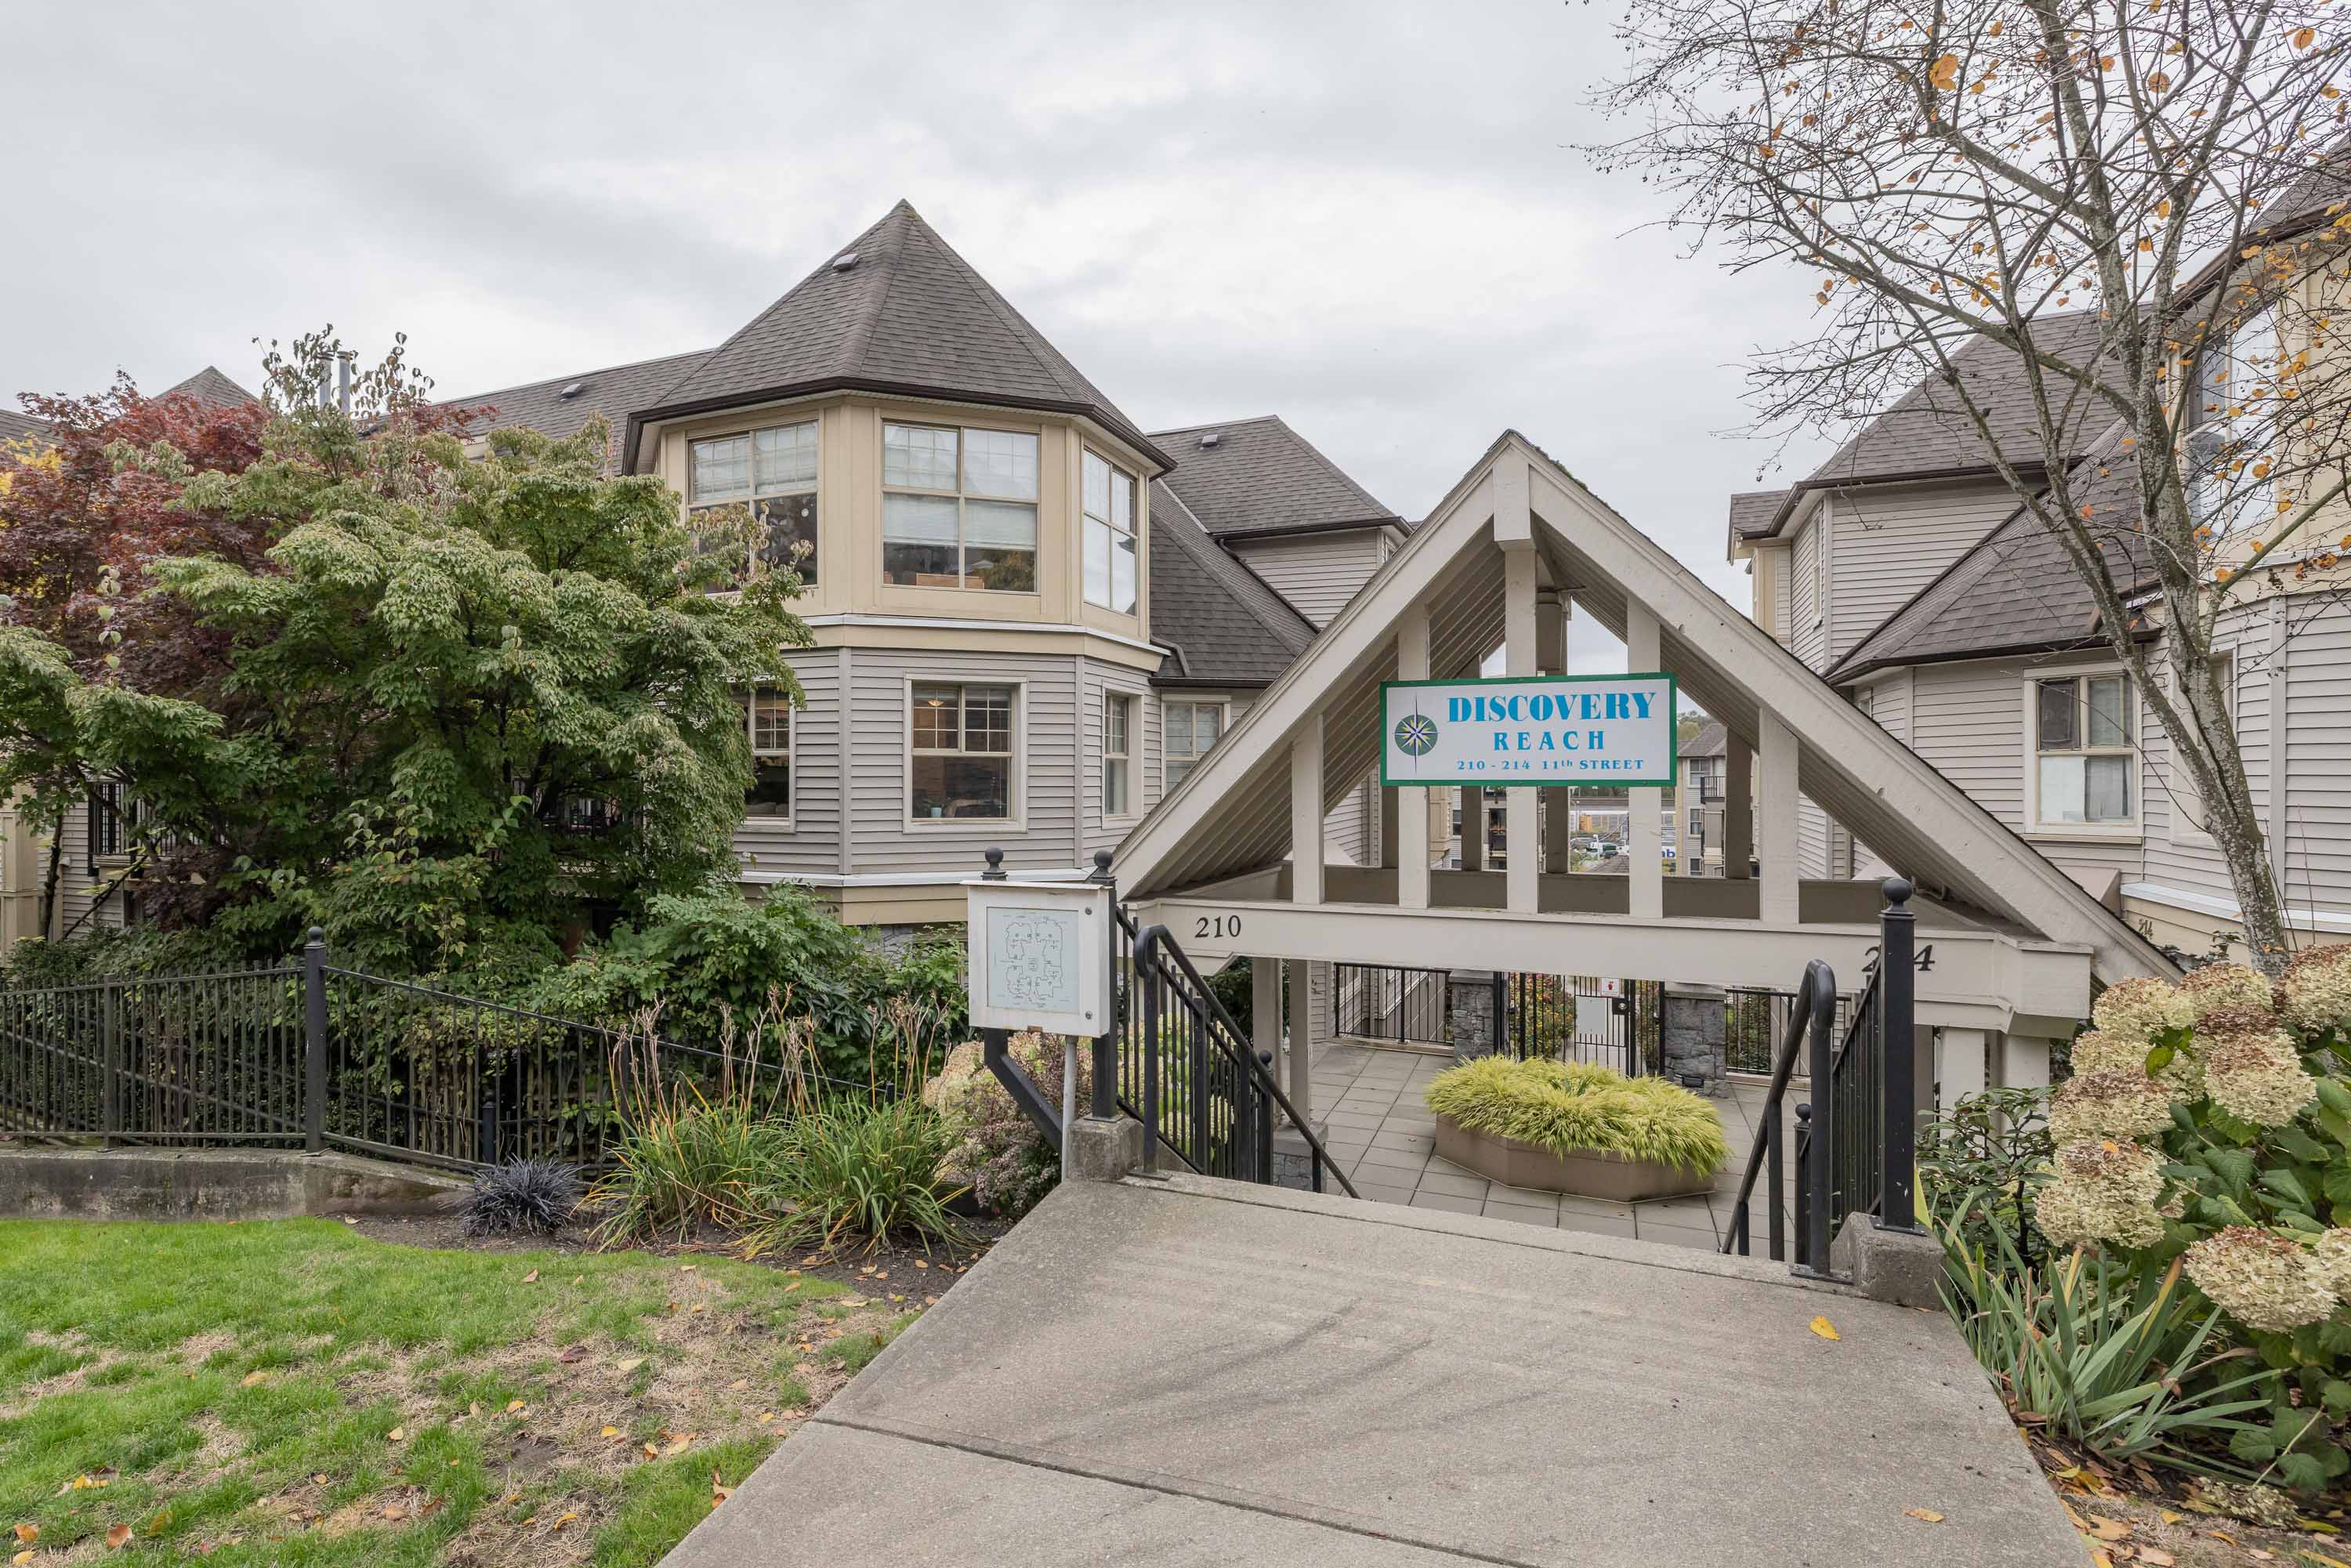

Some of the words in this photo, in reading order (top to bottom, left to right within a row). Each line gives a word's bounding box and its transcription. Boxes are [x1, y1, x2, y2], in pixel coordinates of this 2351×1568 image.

[1447, 691, 1657, 722] DISCOVERY
[1494, 730, 1605, 751] REACH
[1457, 759, 1487, 770] 210
[1503, 759, 1531, 770] 214
[1541, 759, 1573, 770] 11th
[1579, 758, 1643, 770] STREET
[1194, 914, 1241, 938] 210
[1862, 944, 1936, 972] 24
